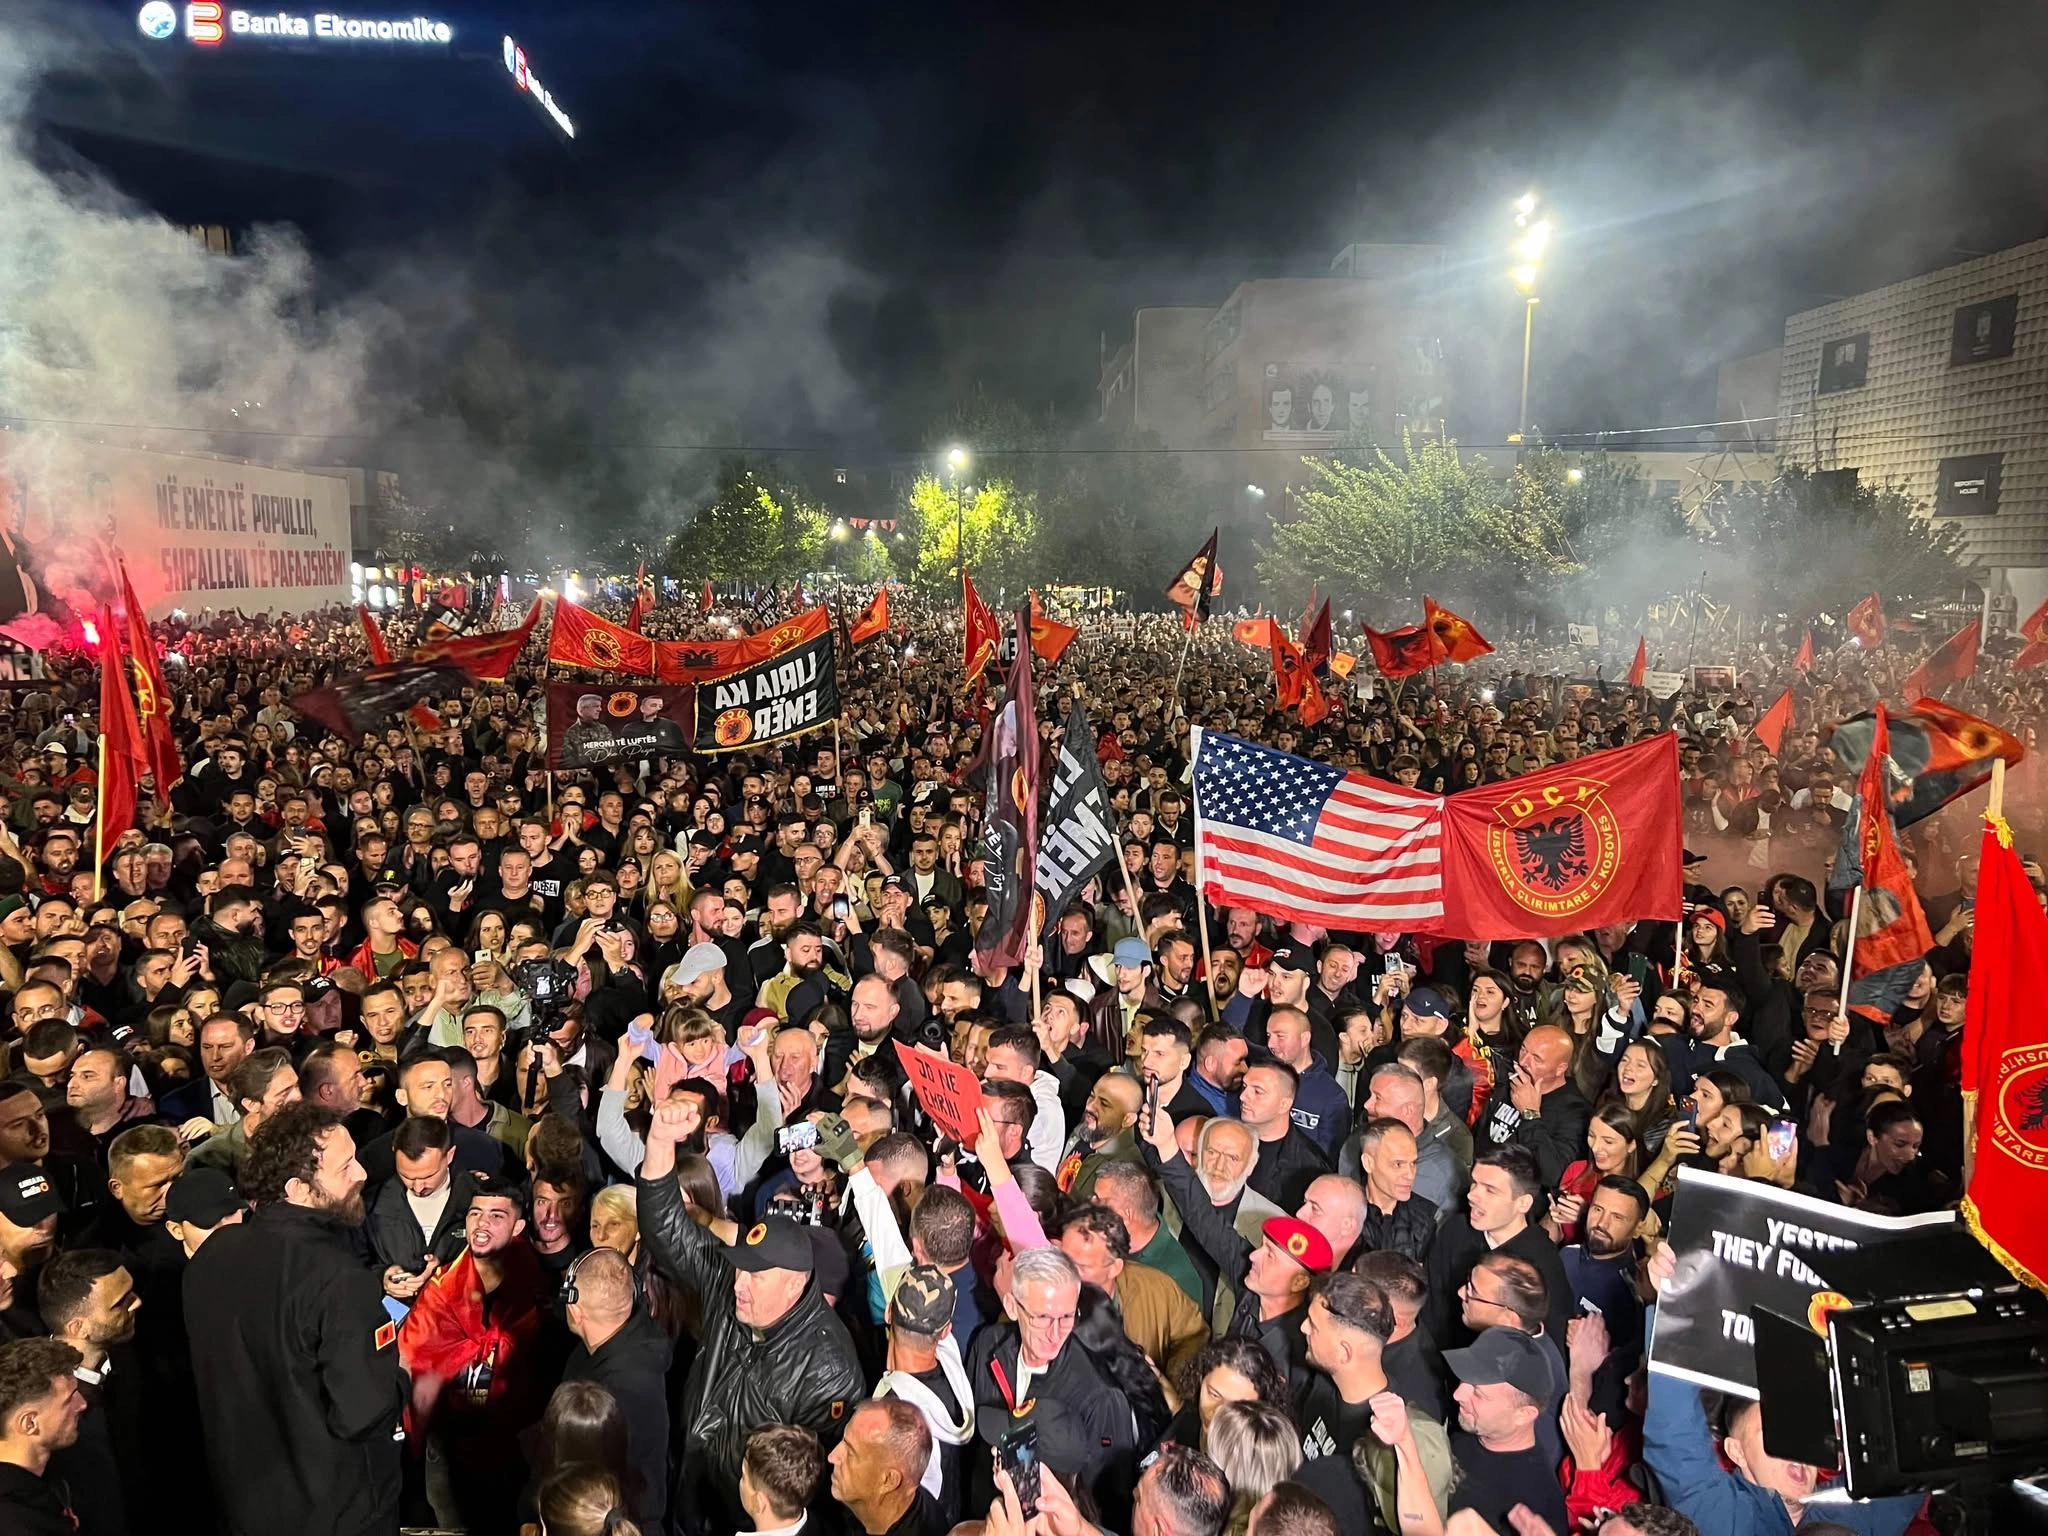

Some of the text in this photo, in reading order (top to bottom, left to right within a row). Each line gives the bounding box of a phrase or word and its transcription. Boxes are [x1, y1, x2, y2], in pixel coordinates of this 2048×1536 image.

[231, 9, 309, 36] Banka
[314, 13, 452, 42] Ekonomike
[183, 478, 228, 532] EMËR
[228, 481, 248, 533] TË
[252, 493, 317, 540] POPULLIT,
[250, 540, 269, 589] TË
[583, 734, 658, 750] HERONJ TË LUFTËS
[1492, 815, 1615, 912] USHTRIA ÇLIRIMTARE E KOSOVËS
[1711, 1230, 1773, 1272] THEY
[1721, 1309, 1756, 1345] TO
